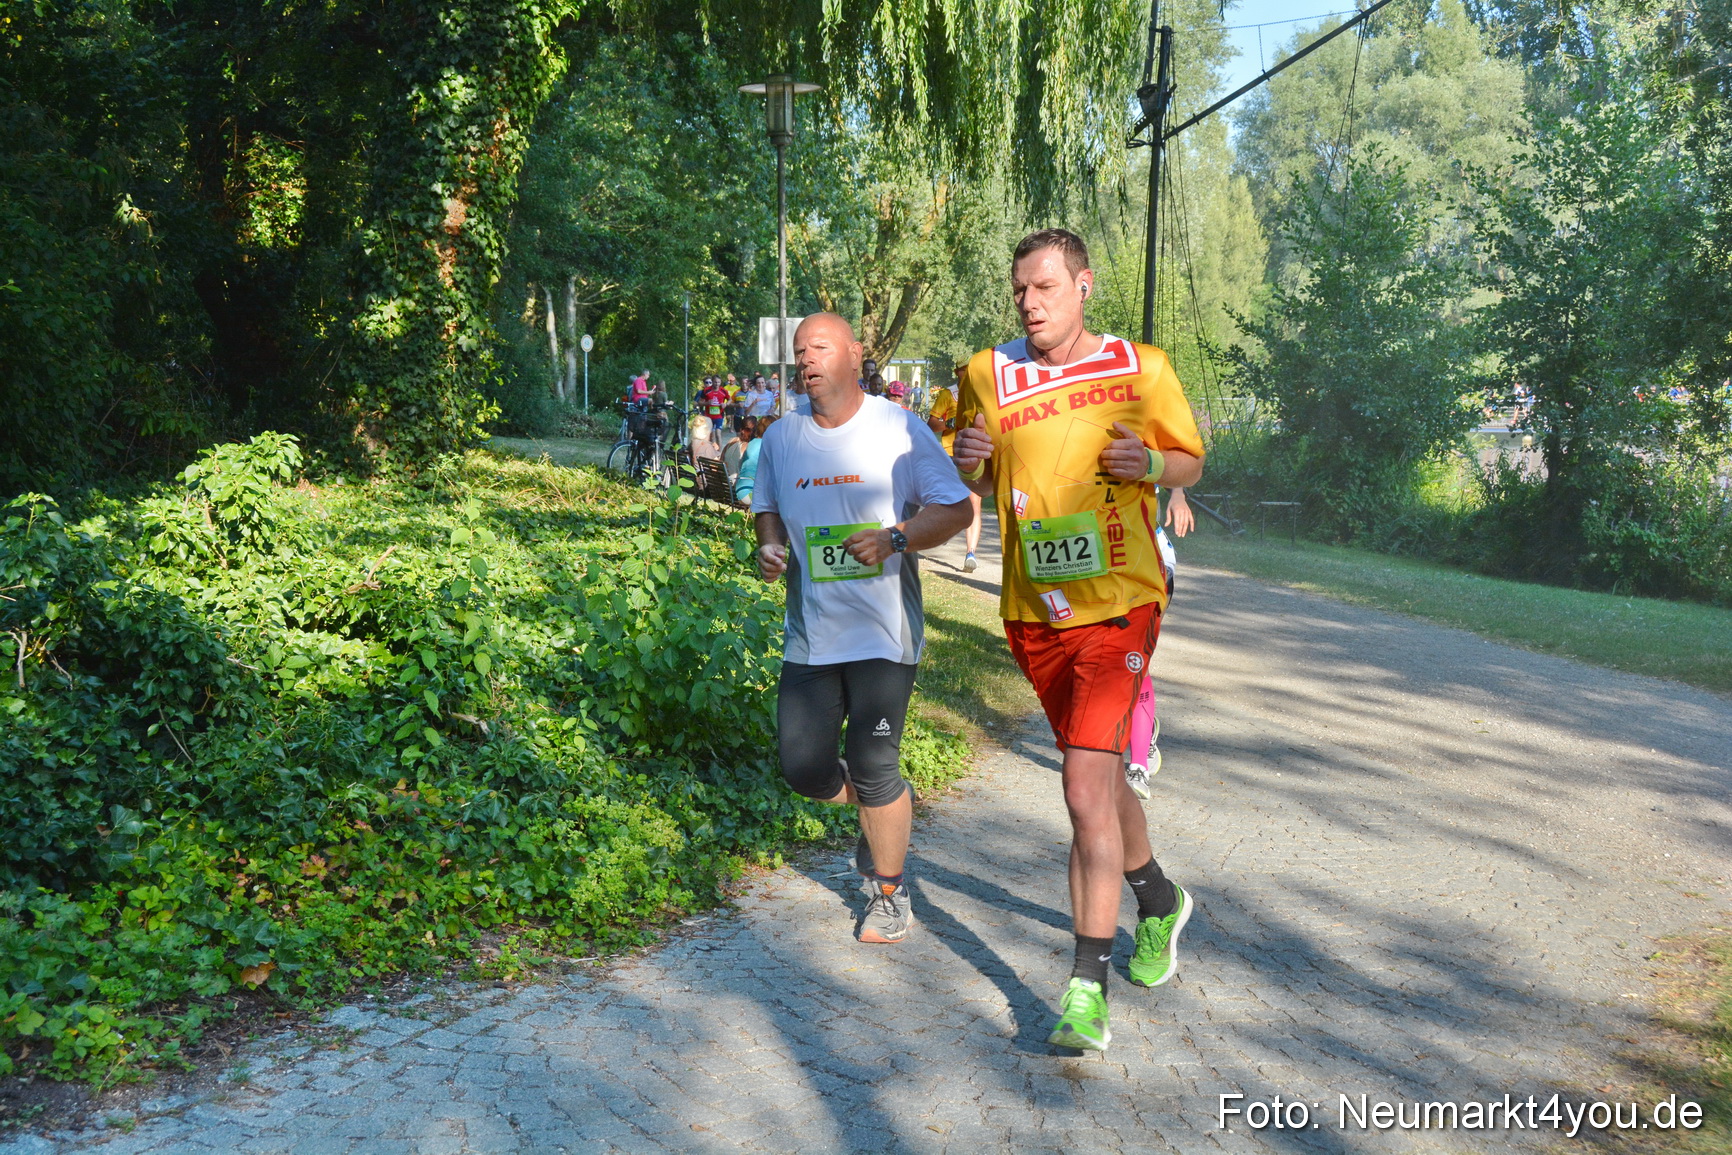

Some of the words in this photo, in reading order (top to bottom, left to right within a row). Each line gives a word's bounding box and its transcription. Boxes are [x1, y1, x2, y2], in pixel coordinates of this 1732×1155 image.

[999, 398, 1061, 435] MAX
[1068, 384, 1142, 411] BÖGL
[813, 474, 865, 487] KLEBL
[823, 545, 854, 566] 87
[1031, 536, 1092, 564] 1212
[1063, 560, 1093, 570] Christian
